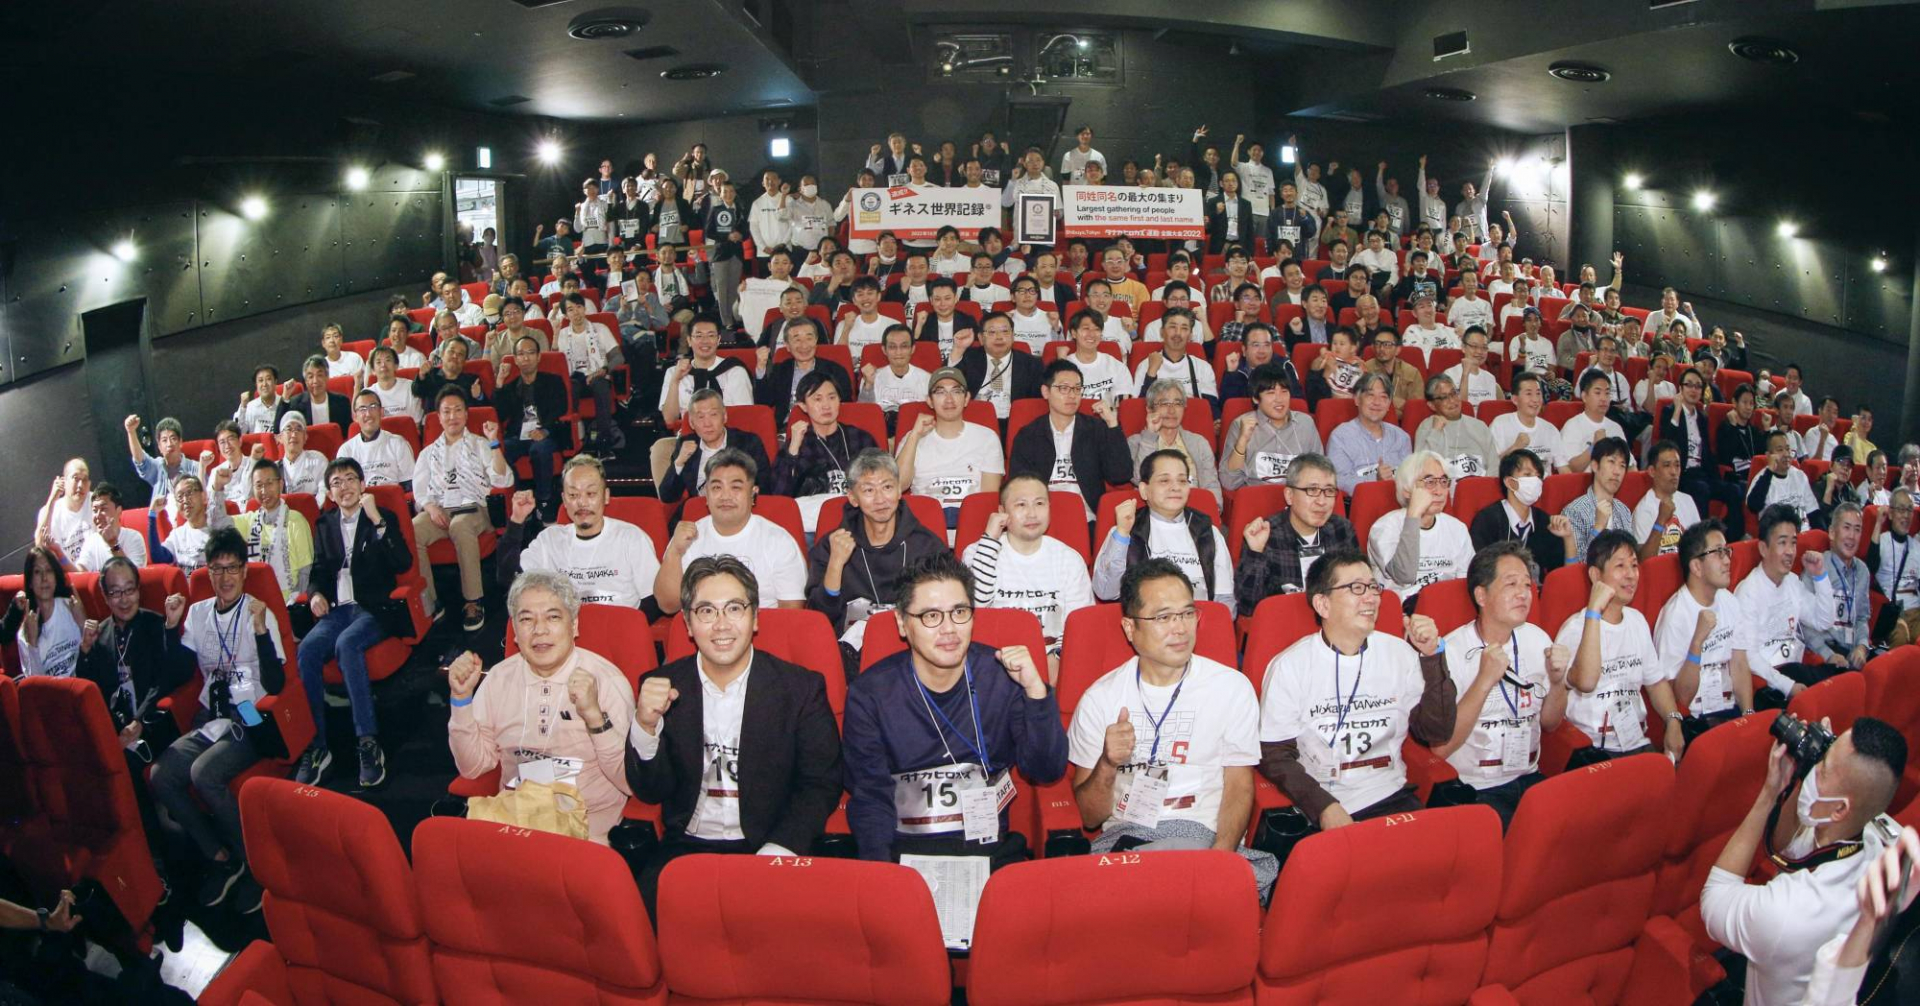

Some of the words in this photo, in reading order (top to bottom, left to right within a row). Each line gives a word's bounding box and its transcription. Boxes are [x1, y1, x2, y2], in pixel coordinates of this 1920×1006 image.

[1076, 192, 1184, 203] 同姓同名の最大の集まり
[1077, 205, 1105, 213] Largest
[1057, 465, 1076, 479] 54
[1461, 461, 1477, 473] 50
[449, 473, 457, 484] 2
[1837, 602, 1845, 618] 8
[1780, 643, 1790, 658] 6
[1340, 732, 1372, 755] 13
[293, 787, 320, 797] A-15
[921, 782, 958, 808] 15
[996, 781, 1012, 802] TAFF
[1386, 813, 1417, 827] A-11
[769, 856, 813, 867] A-13
[1098, 854, 1141, 866] A-12
